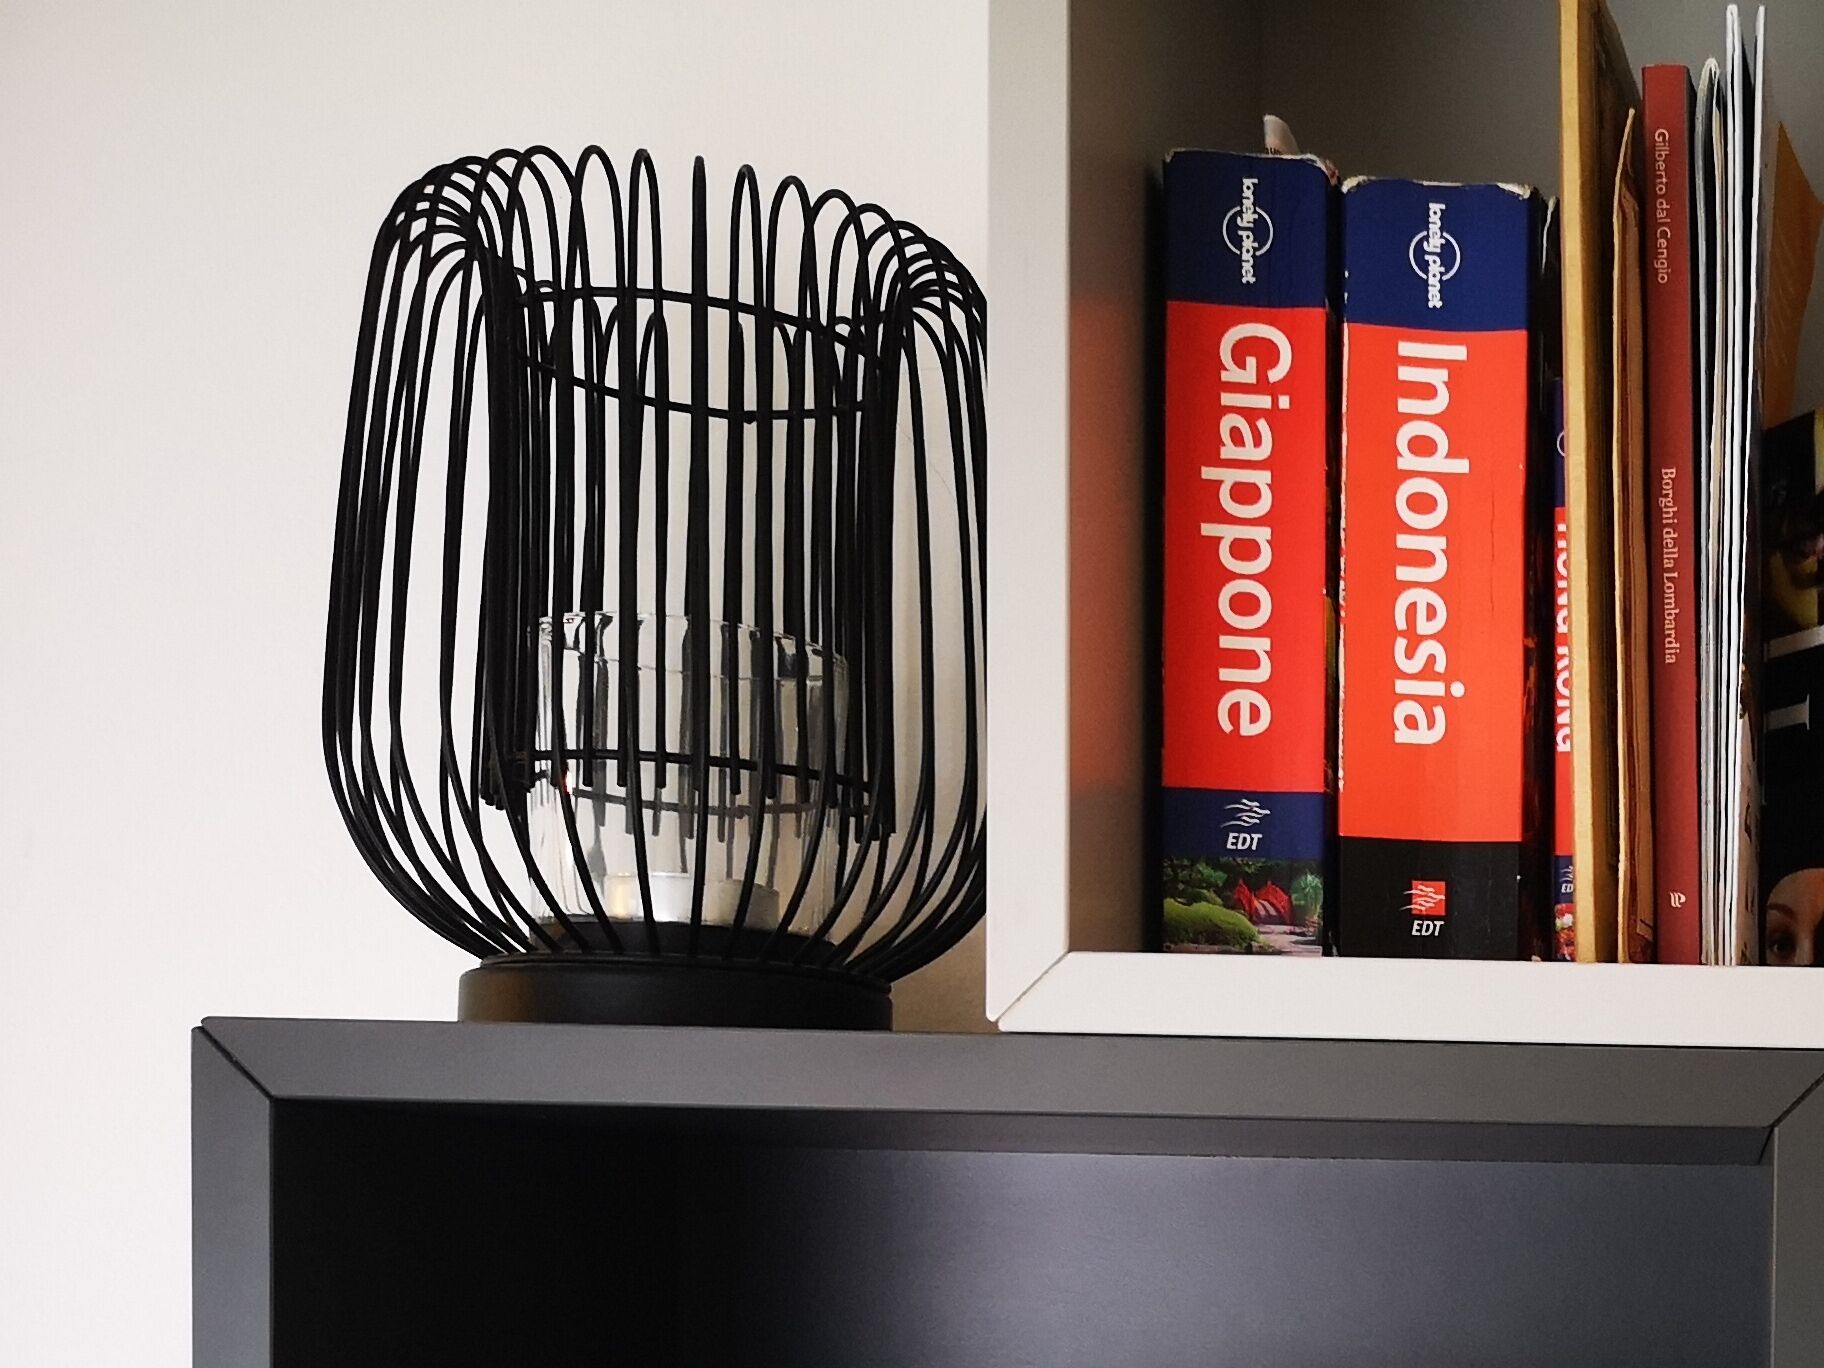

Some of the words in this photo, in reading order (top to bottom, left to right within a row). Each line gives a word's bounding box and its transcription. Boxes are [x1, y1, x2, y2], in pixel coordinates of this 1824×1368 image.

[1654, 128, 1670, 196] Gilberto
[1236, 178, 1259, 228] lonely
[1423, 202, 1446, 253] lonely
[1656, 199, 1671, 223] dal
[1237, 229, 1259, 284] planet
[1424, 254, 1445, 309] planet
[1653, 226, 1672, 284] Cengio
[1658, 467, 1678, 524] Borghi
[1200, 322, 1292, 737] Giappone
[1393, 339, 1470, 745] Indonesia
[1662, 527, 1679, 569] della
[1663, 572, 1680, 664] Lombardia
[1226, 832, 1263, 851] EDT
[1410, 920, 1446, 937] EDT
